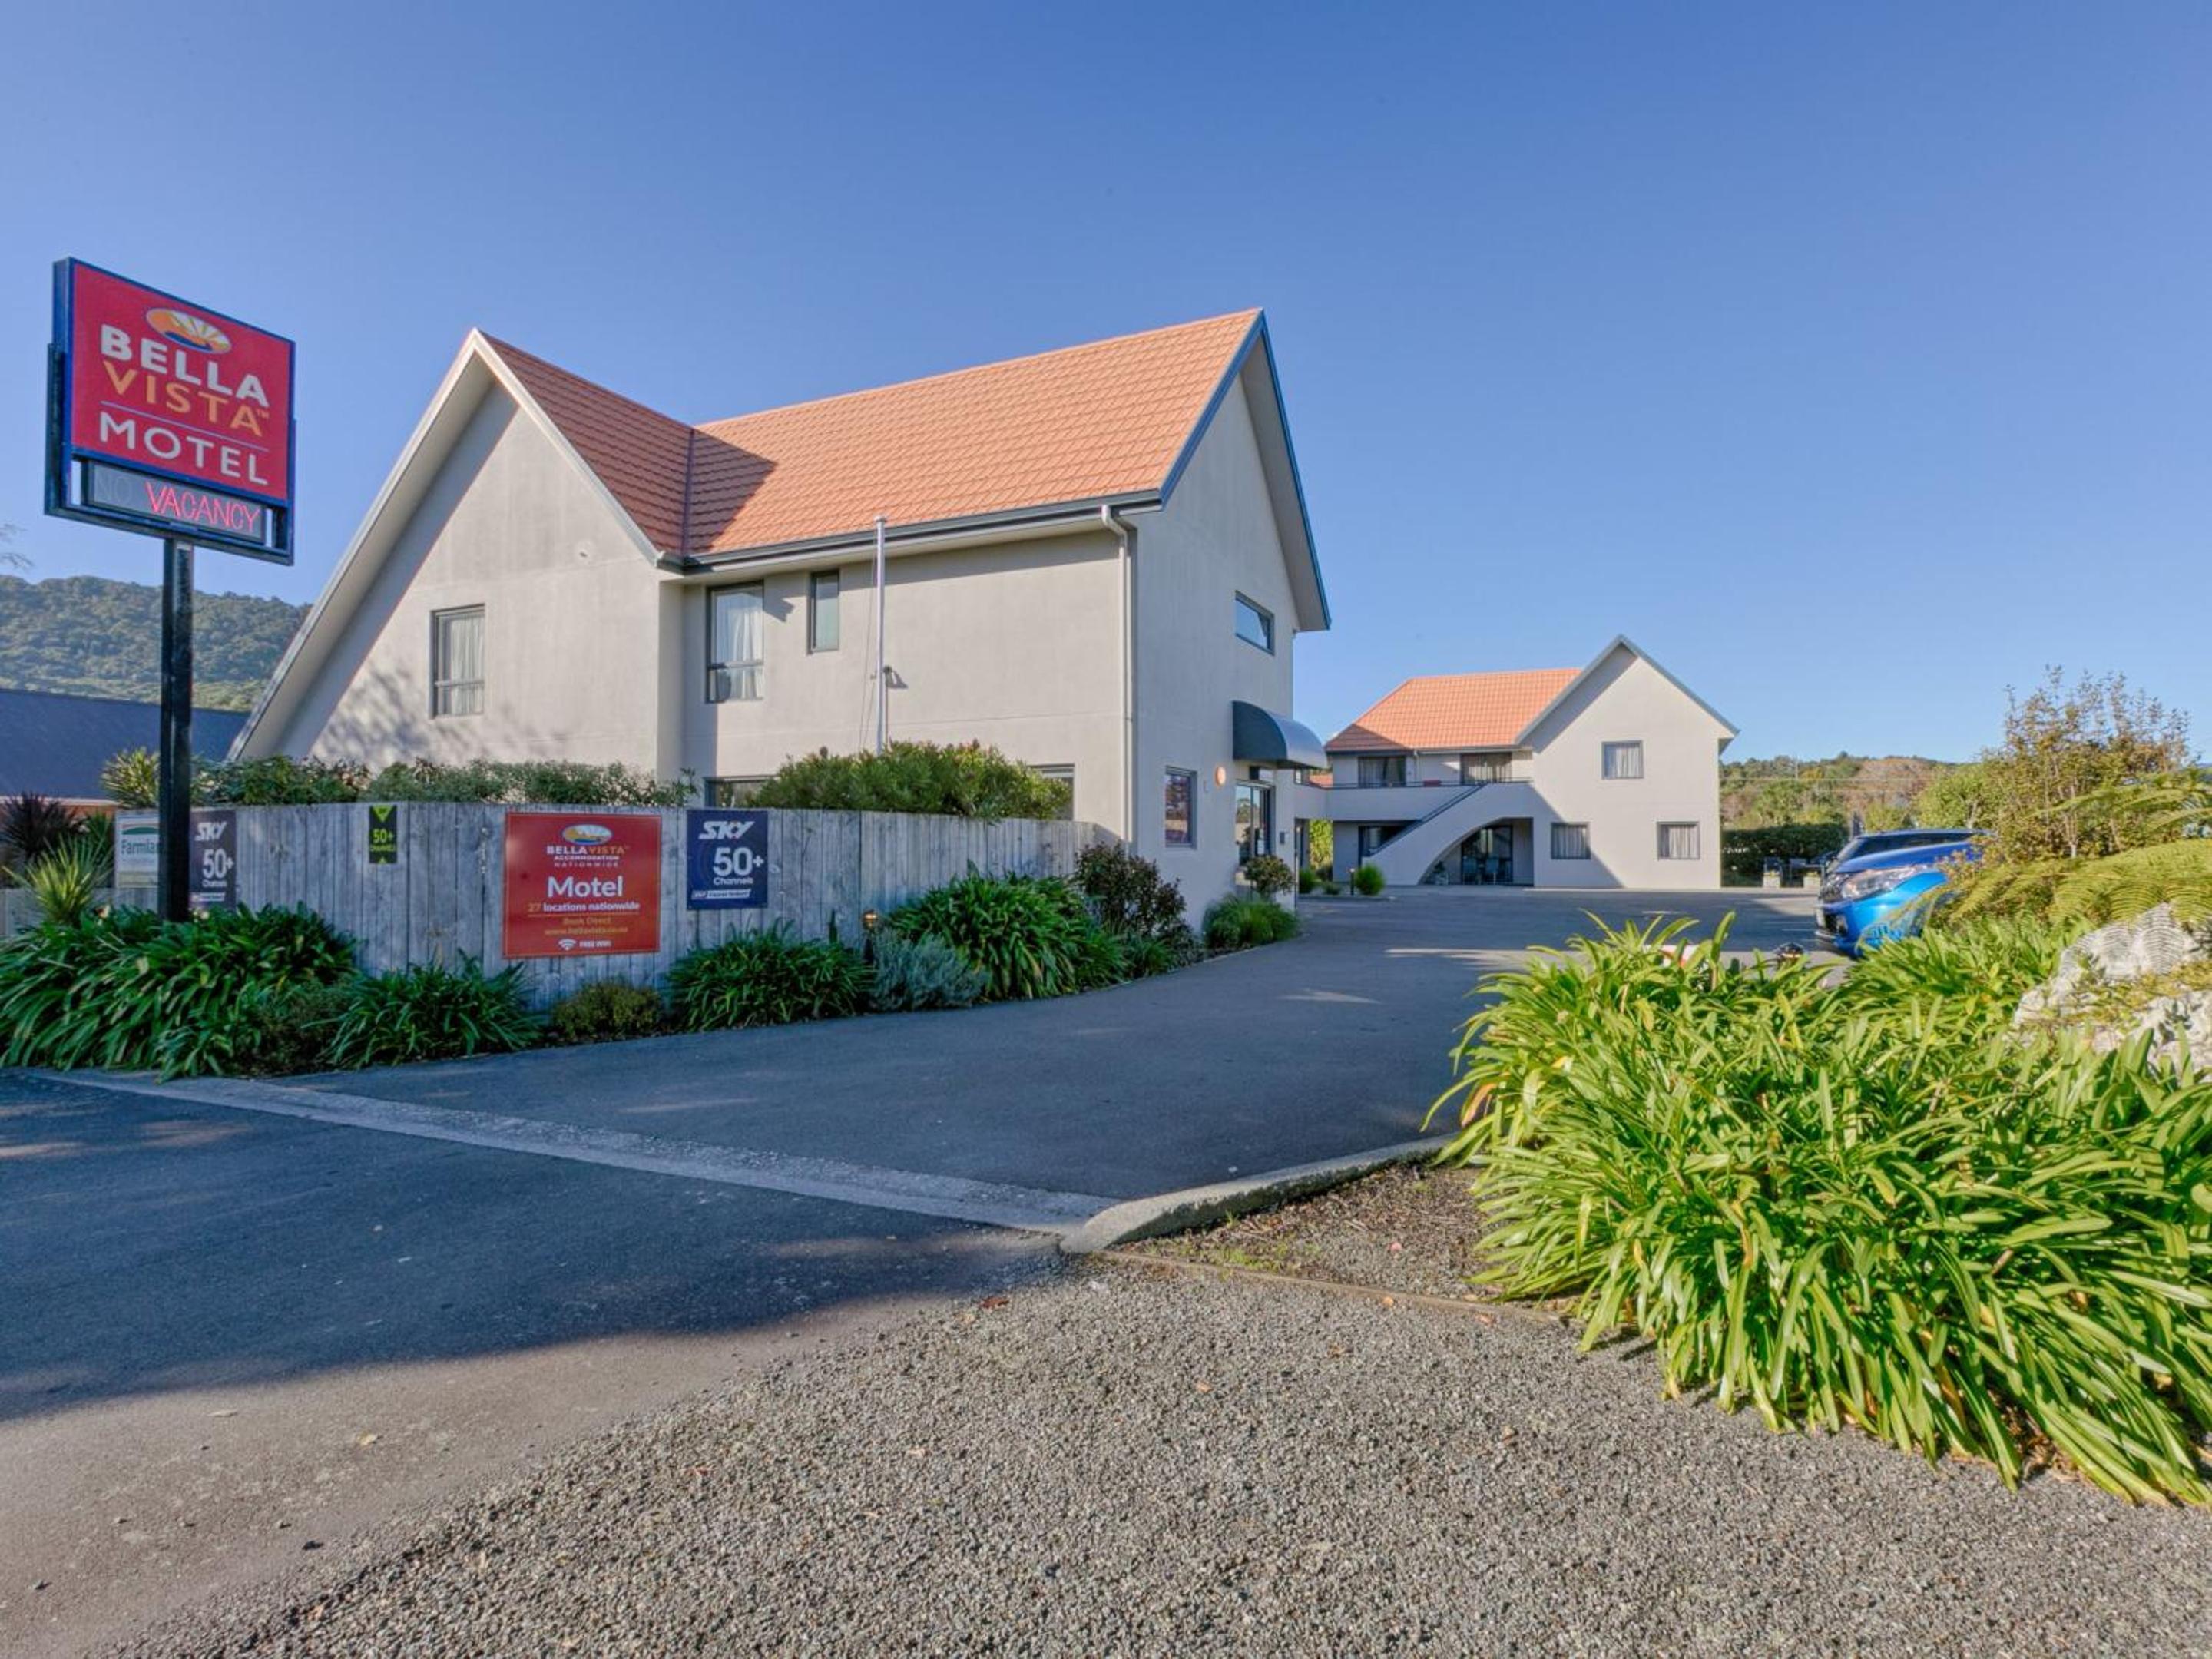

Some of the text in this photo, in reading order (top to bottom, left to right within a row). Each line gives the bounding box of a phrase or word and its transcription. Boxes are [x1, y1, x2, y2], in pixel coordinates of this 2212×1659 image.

[100, 323, 270, 407] BELLA
[98, 411, 269, 486] MOTEL
[145, 480, 260, 532] VACANCY
[195, 821, 227, 841] SKY
[373, 829, 394, 843] 50+
[698, 820, 756, 839] SKY
[547, 846, 588, 855] BELLA
[713, 846, 765, 876] 50+
[203, 849, 234, 879] 50+
[547, 875, 624, 898] Motel
[713, 876, 753, 886] Channels
[543, 902, 587, 912] locations
[588, 900, 641, 911] nationwide
